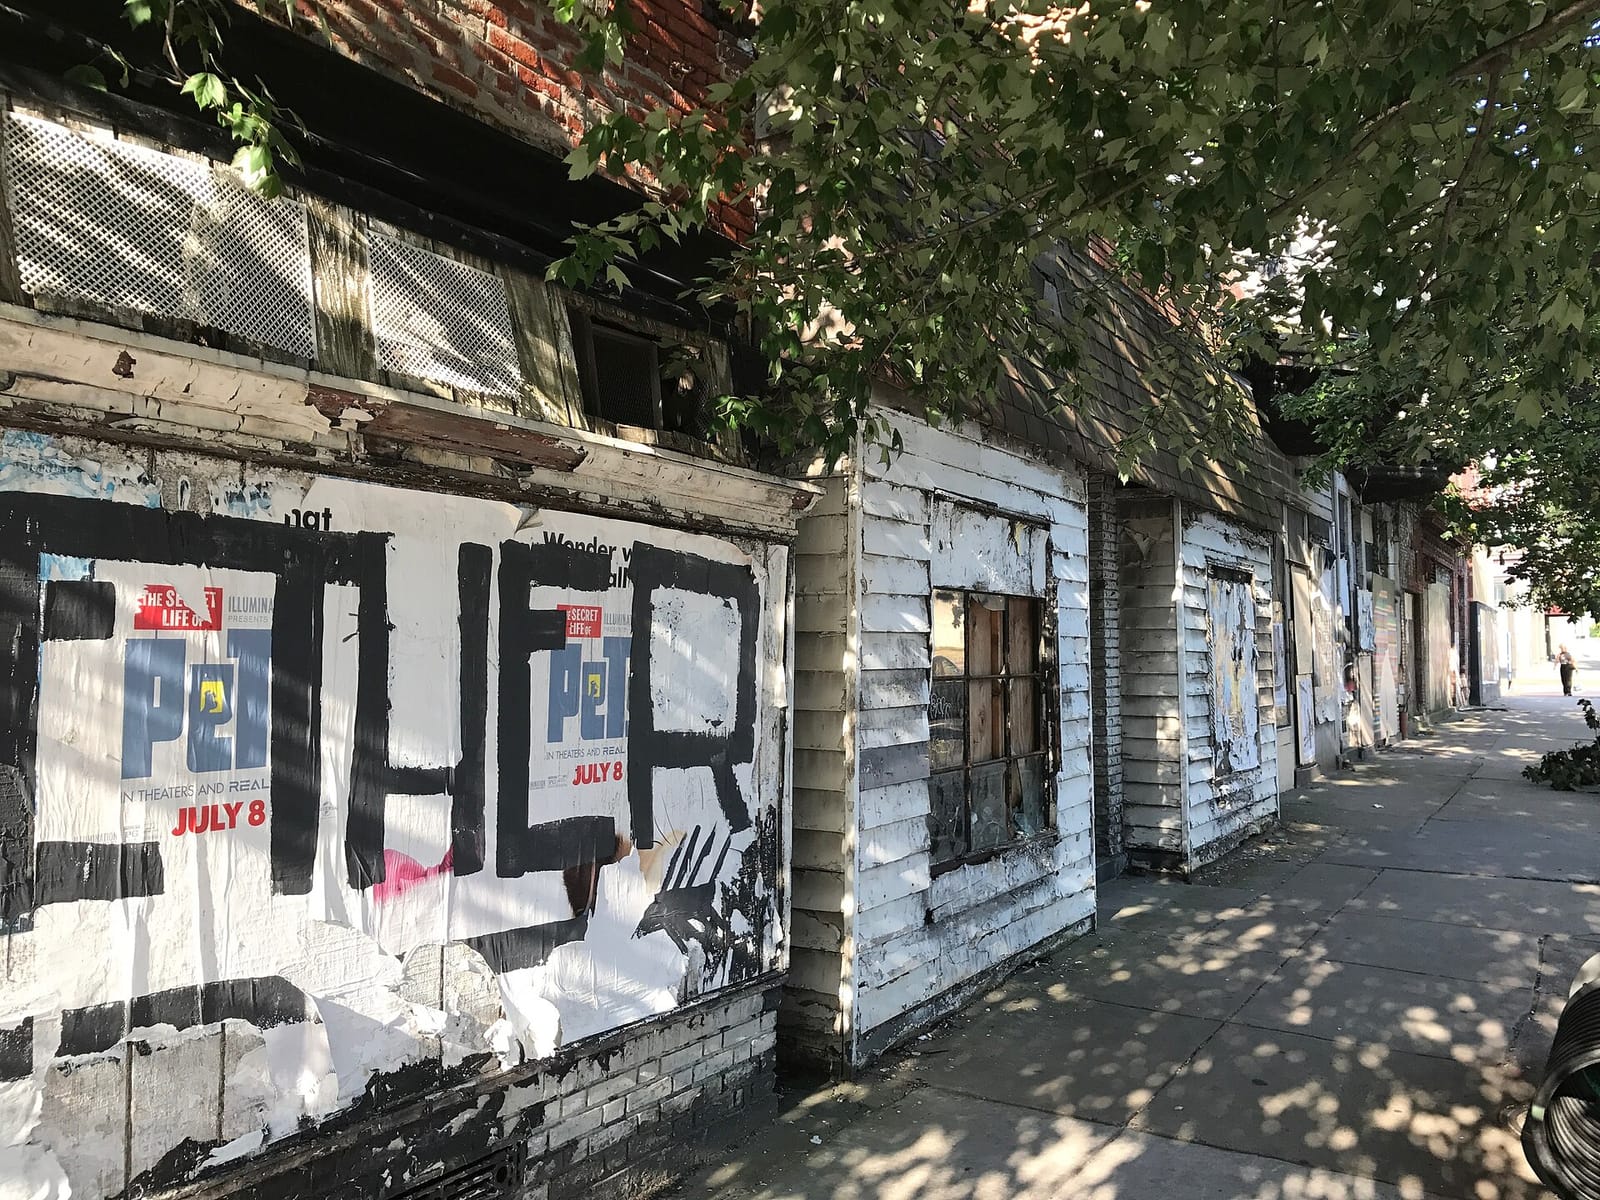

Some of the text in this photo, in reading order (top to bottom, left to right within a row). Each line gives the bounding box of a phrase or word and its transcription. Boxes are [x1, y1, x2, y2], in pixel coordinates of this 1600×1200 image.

[143, 590, 163, 607] THE
[162, 609, 190, 627] LIFE
[571, 607, 598, 622] SECRET
[569, 622, 585, 635] LIFE
[556, 749, 585, 759] THEATERS
[586, 747, 601, 757] AND
[603, 746, 625, 756] REAL
[572, 762, 611, 786] JULY
[613, 761, 623, 781] 8
[138, 785, 194, 802] THEATERS
[198, 782, 224, 796] AND
[229, 777, 270, 793] REAL
[171, 799, 266, 837] JULY 8
